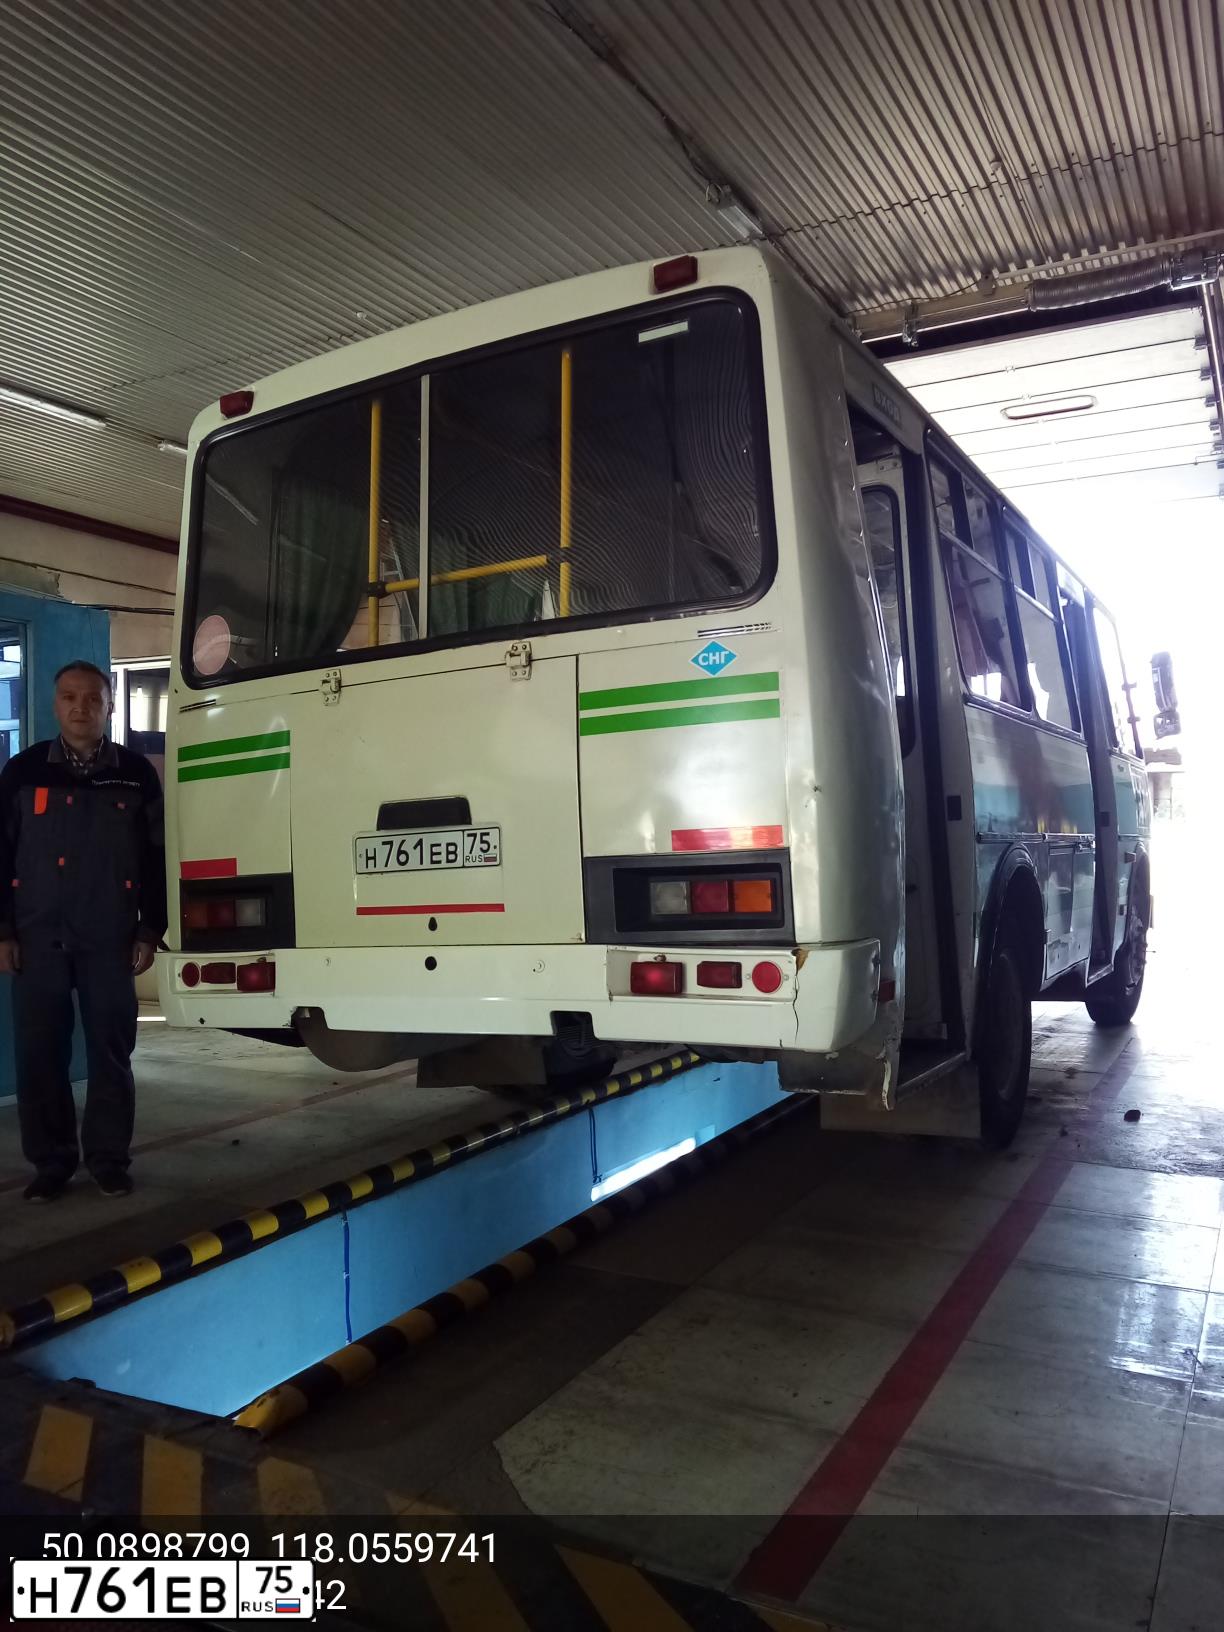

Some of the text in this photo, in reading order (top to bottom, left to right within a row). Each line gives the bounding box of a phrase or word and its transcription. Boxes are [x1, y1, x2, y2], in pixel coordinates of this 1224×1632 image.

[698, 650, 730, 666] СНГ
[467, 832, 491, 854] 75
[465, 854, 483, 863] RUS
